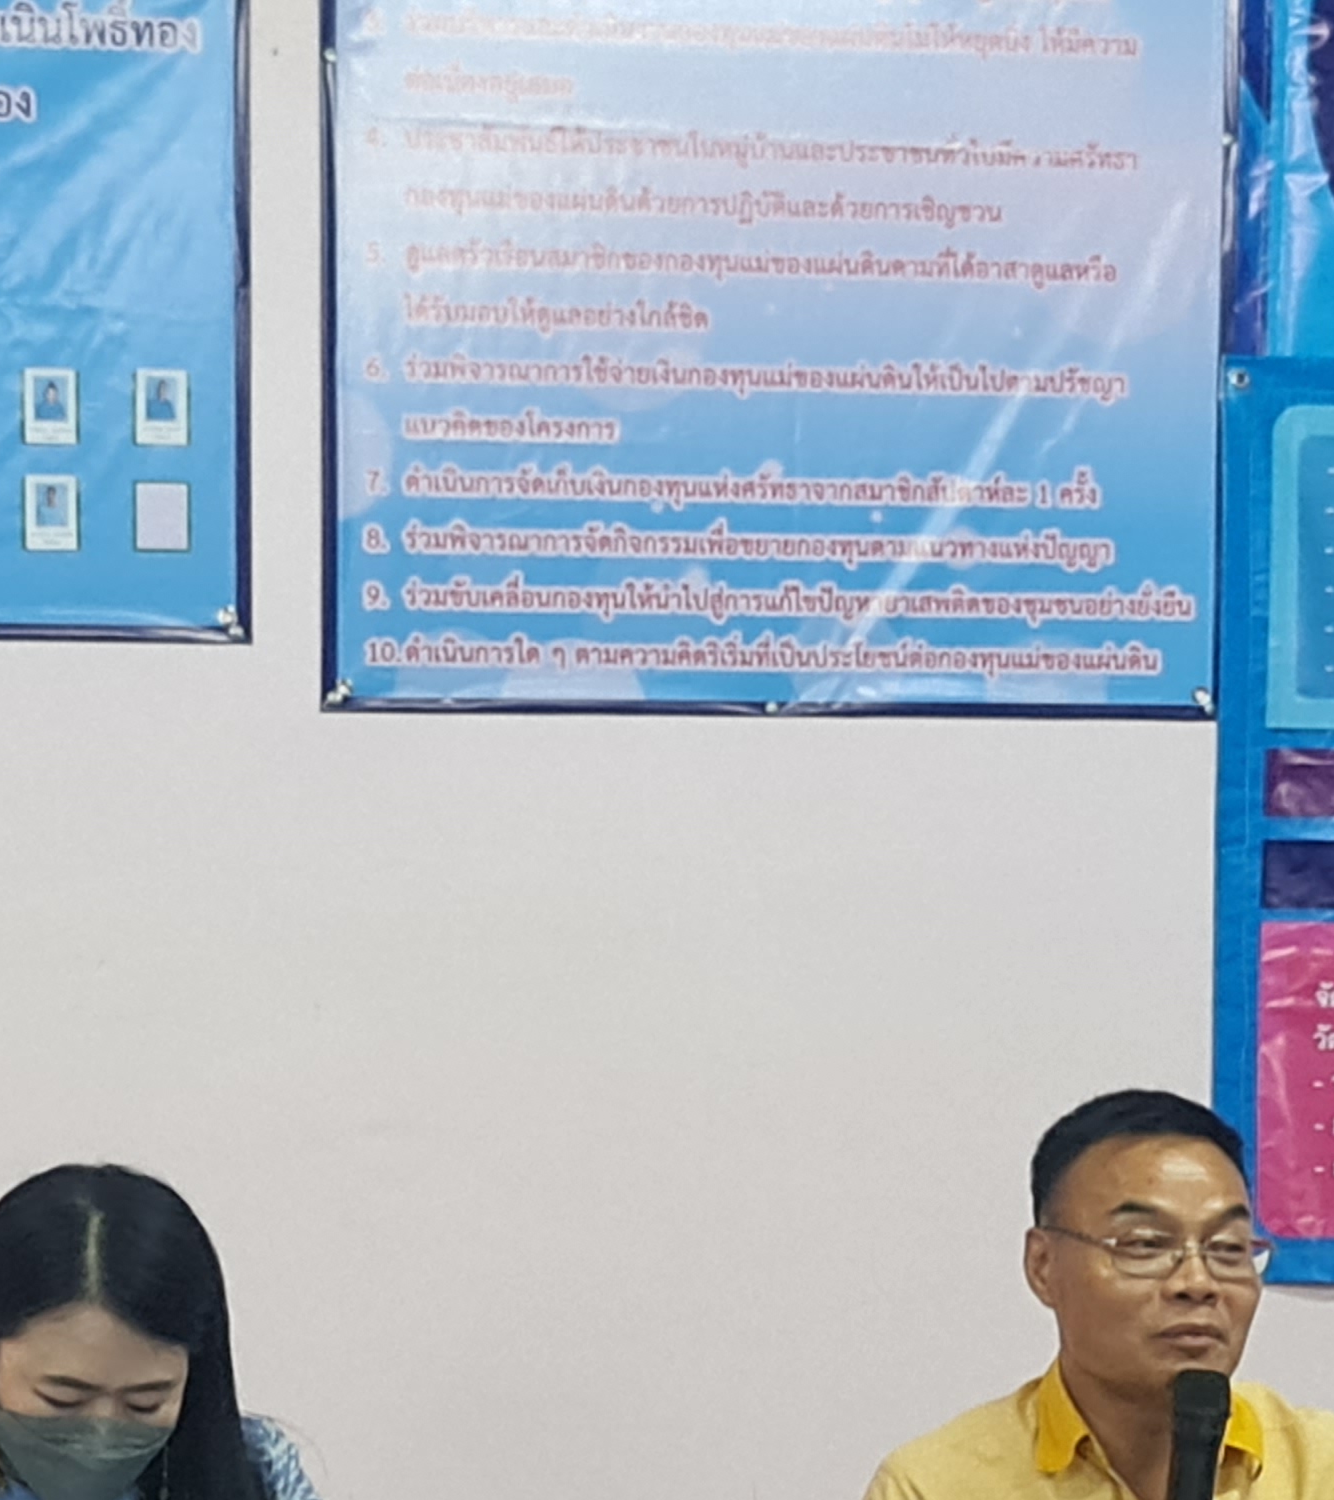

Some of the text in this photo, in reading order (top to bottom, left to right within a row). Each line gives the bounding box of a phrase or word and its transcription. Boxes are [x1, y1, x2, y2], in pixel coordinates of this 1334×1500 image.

[1060, 468, 1099, 506] ครั้ง
[365, 527, 386, 550] 8.
[365, 584, 386, 607] 9.
